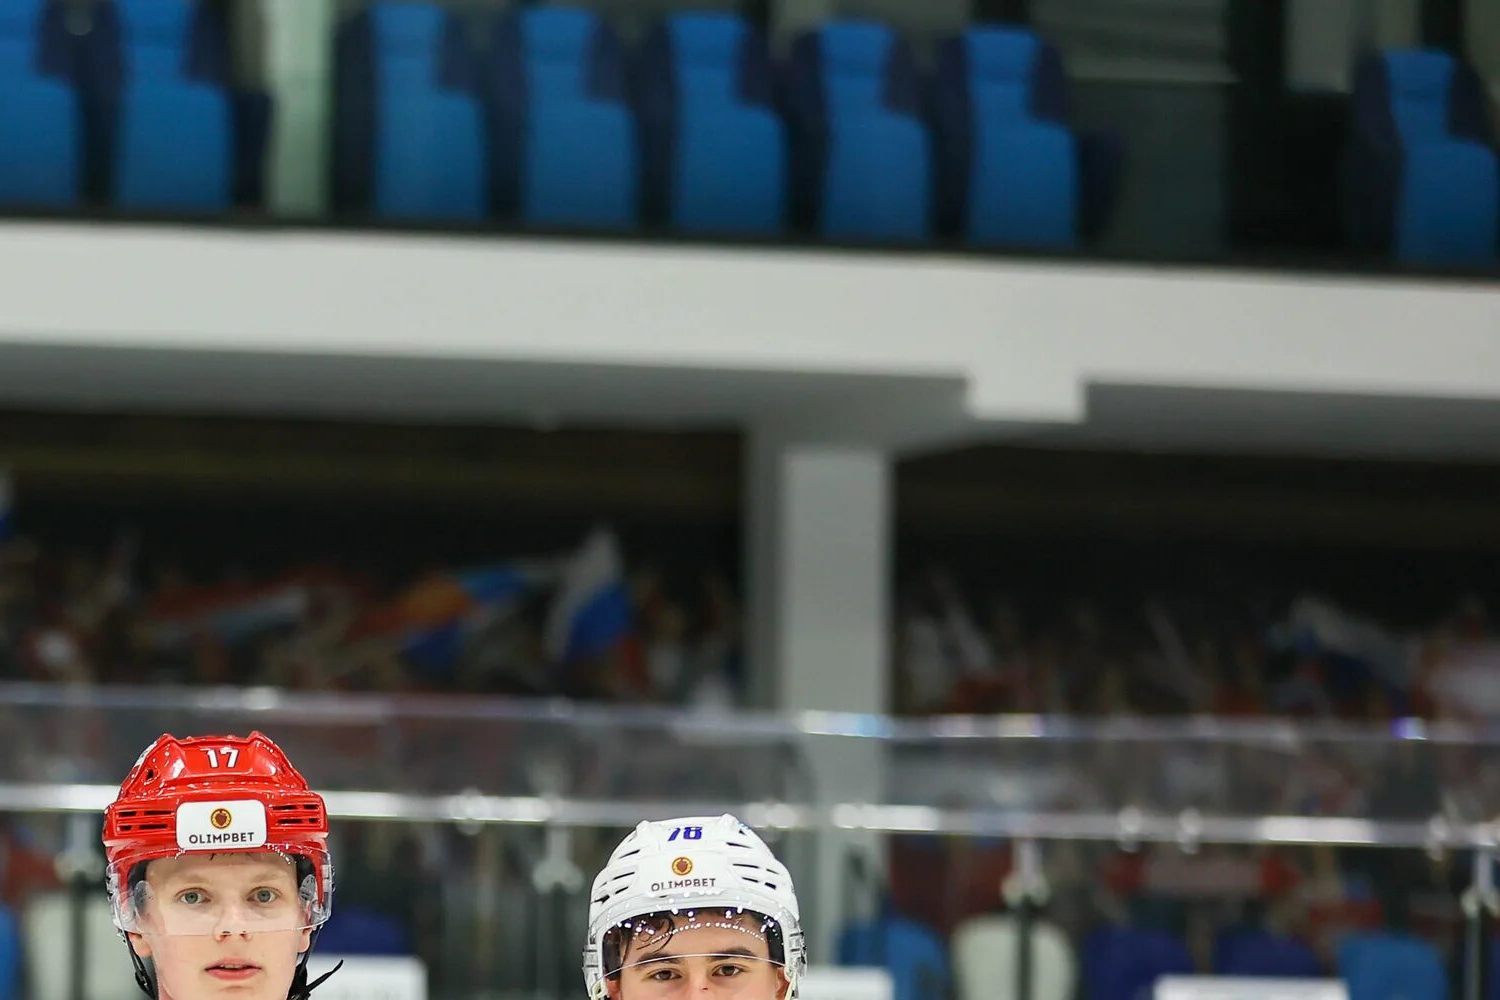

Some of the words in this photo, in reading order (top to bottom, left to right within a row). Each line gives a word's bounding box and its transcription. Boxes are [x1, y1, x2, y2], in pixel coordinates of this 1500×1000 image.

[206, 747, 240, 768] 17
[189, 832, 255, 844] OLIMPBET
[651, 878, 716, 892] OLIMPBET
